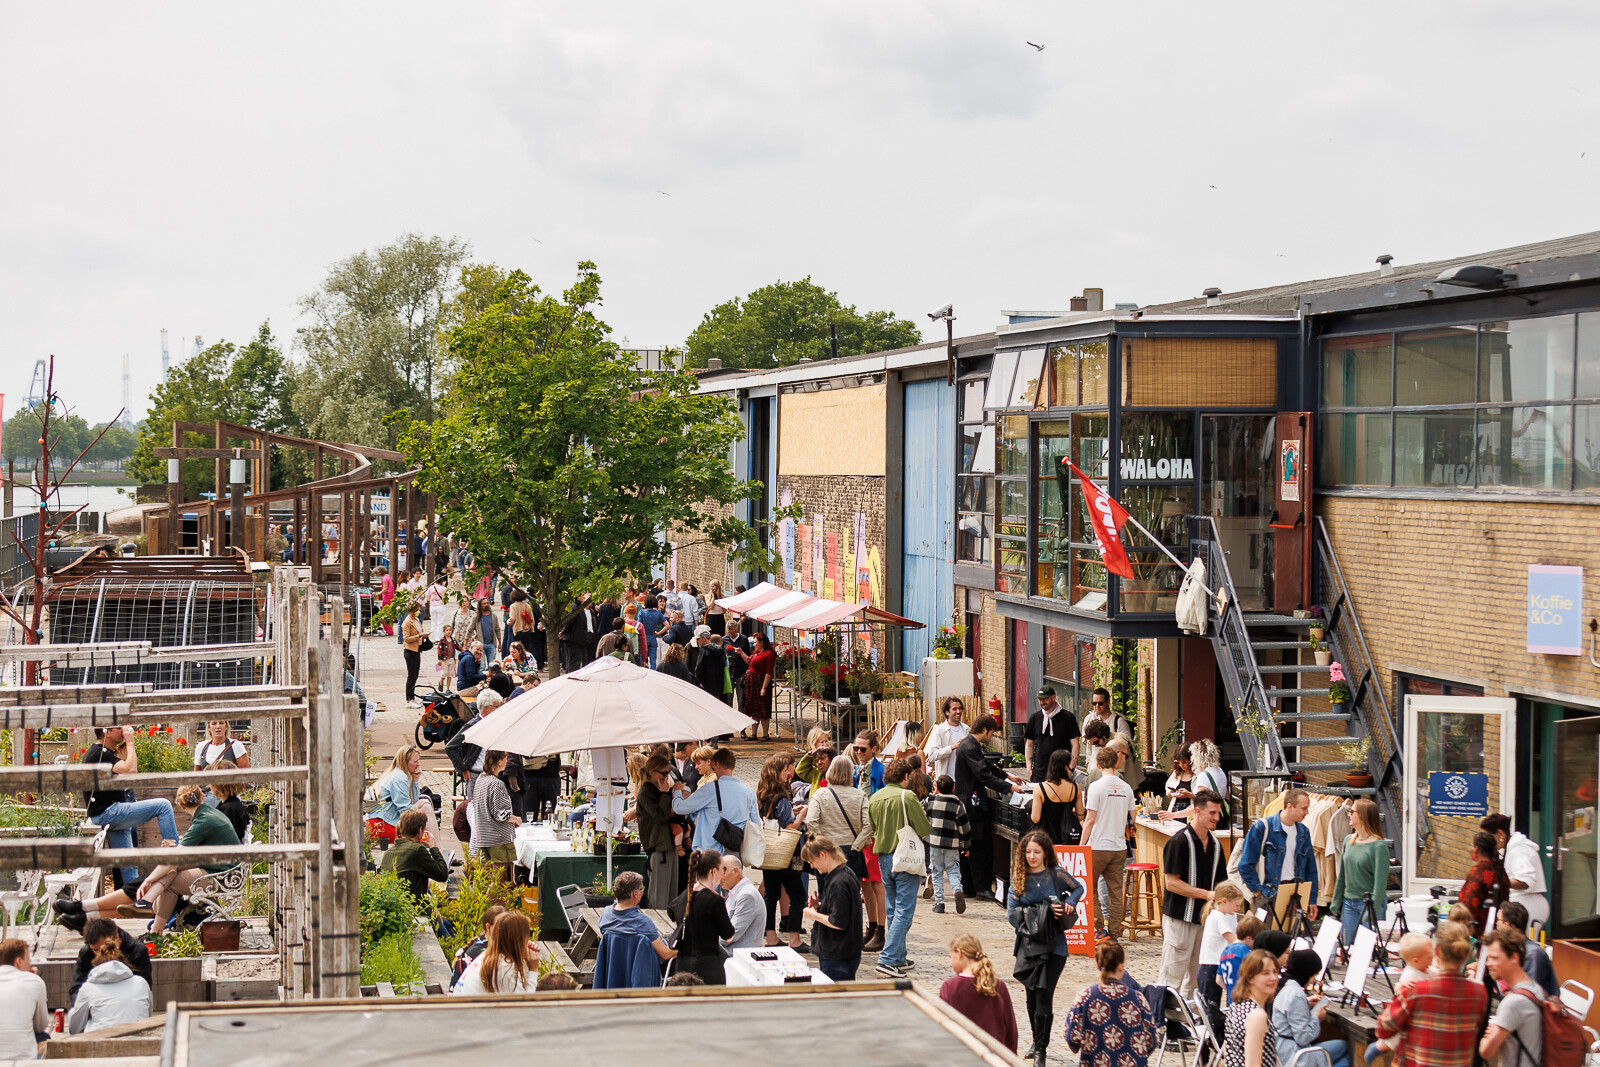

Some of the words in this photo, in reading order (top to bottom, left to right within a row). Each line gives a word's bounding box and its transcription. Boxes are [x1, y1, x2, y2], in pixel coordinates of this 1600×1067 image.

[1121, 458, 1194, 479] WALOHA
[1531, 594, 1573, 610] Koffie
[1530, 609, 1563, 625] &Co
[1056, 852, 1087, 876] WA
